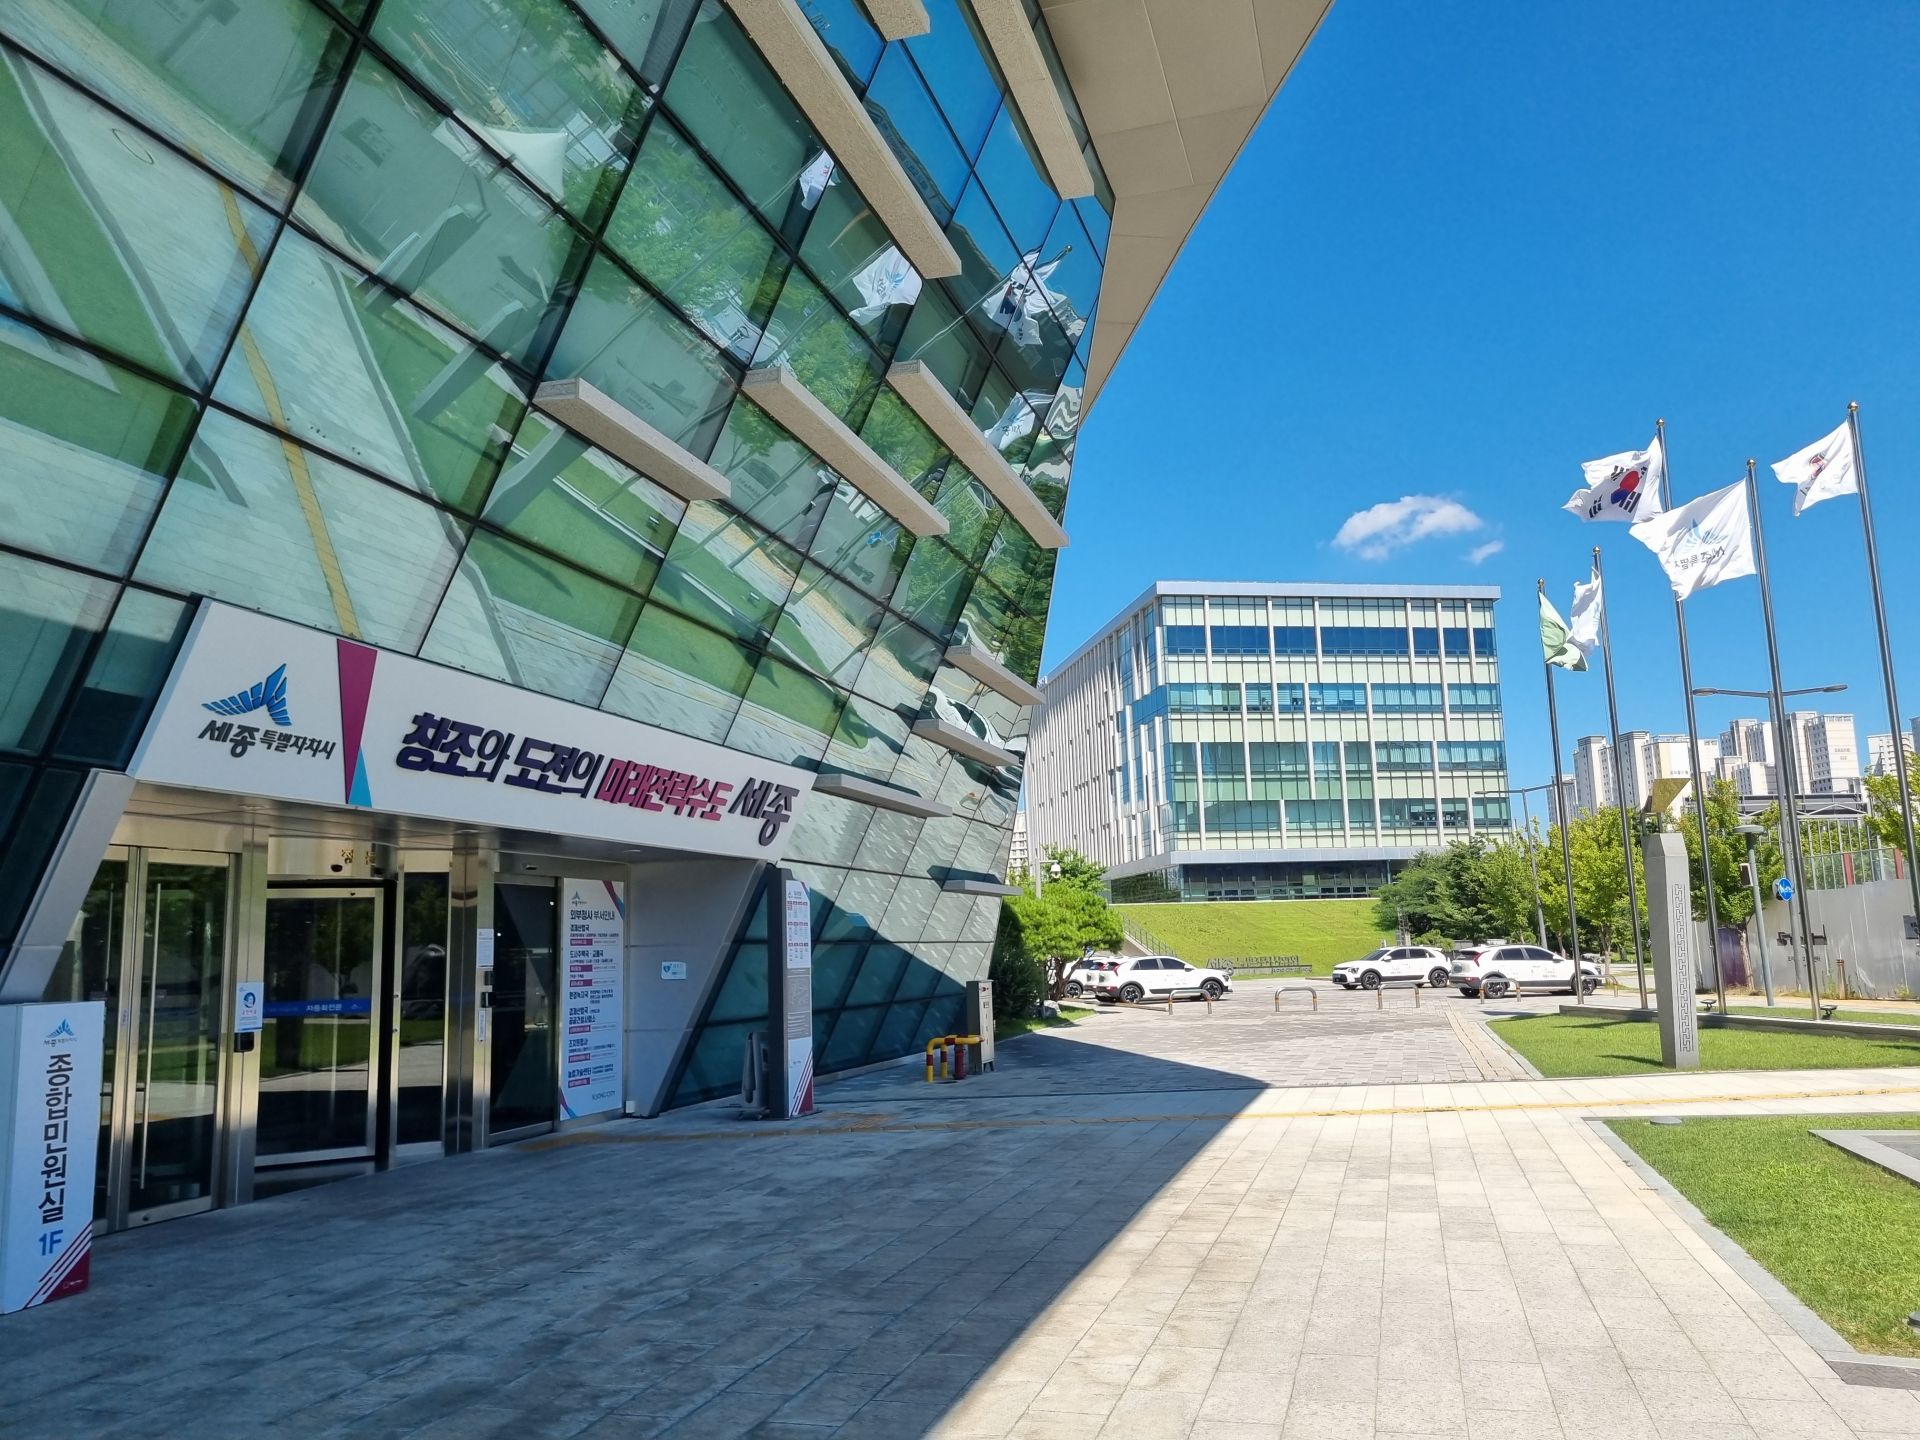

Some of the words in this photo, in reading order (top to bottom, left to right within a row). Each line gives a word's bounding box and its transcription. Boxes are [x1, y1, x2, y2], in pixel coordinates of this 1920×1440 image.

[198, 719, 260, 758] 세종
[259, 729, 336, 760] 특별자치시
[396, 712, 515, 783] 창조와
[504, 737, 604, 798] 도전의
[594, 757, 734, 822] 미래전략수도
[728, 777, 800, 847] 세종
[38, 1053, 74, 1224] 종합민원실
[38, 1230, 64, 1256] 1F
